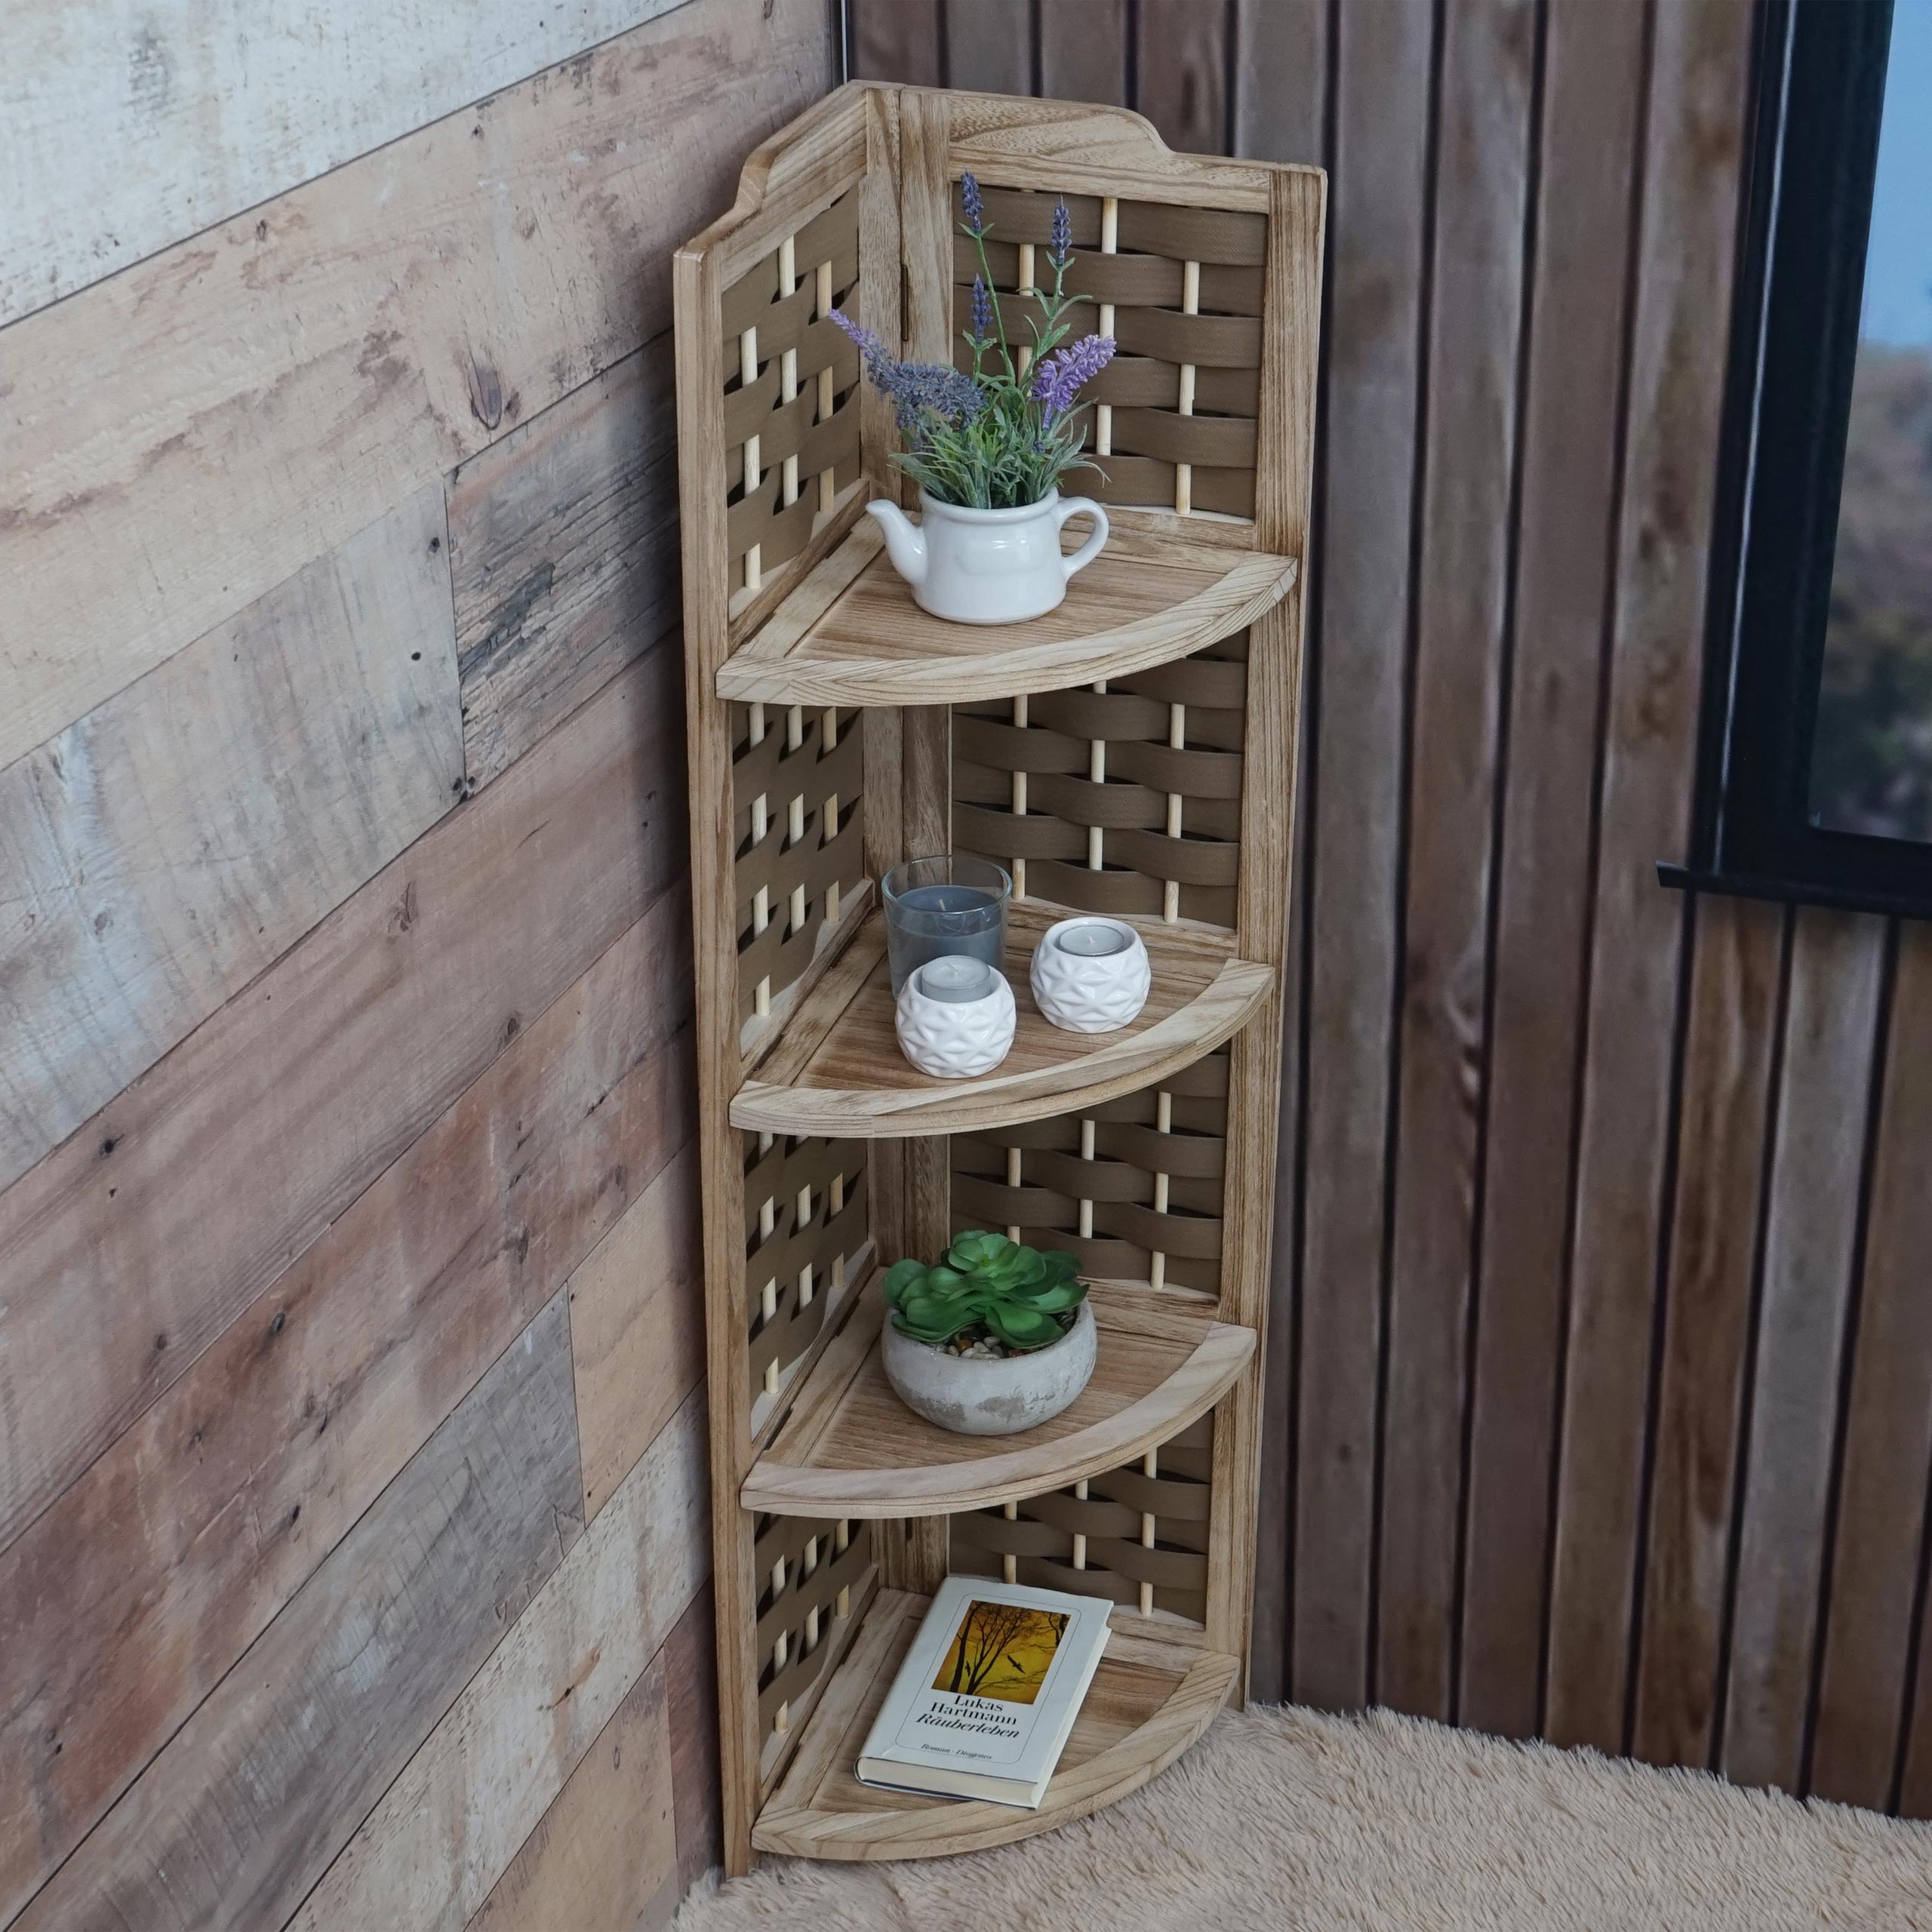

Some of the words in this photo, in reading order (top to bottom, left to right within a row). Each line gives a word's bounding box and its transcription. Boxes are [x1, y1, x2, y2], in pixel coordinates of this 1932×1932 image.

[931, 1702, 1017, 1725] Hartmann
[954, 1695, 1004, 1712] Lukas
[915, 1713, 1020, 1739] Räuberleben
[921, 1743, 951, 1754] Roman
[955, 1749, 993, 1760] Diogenes
